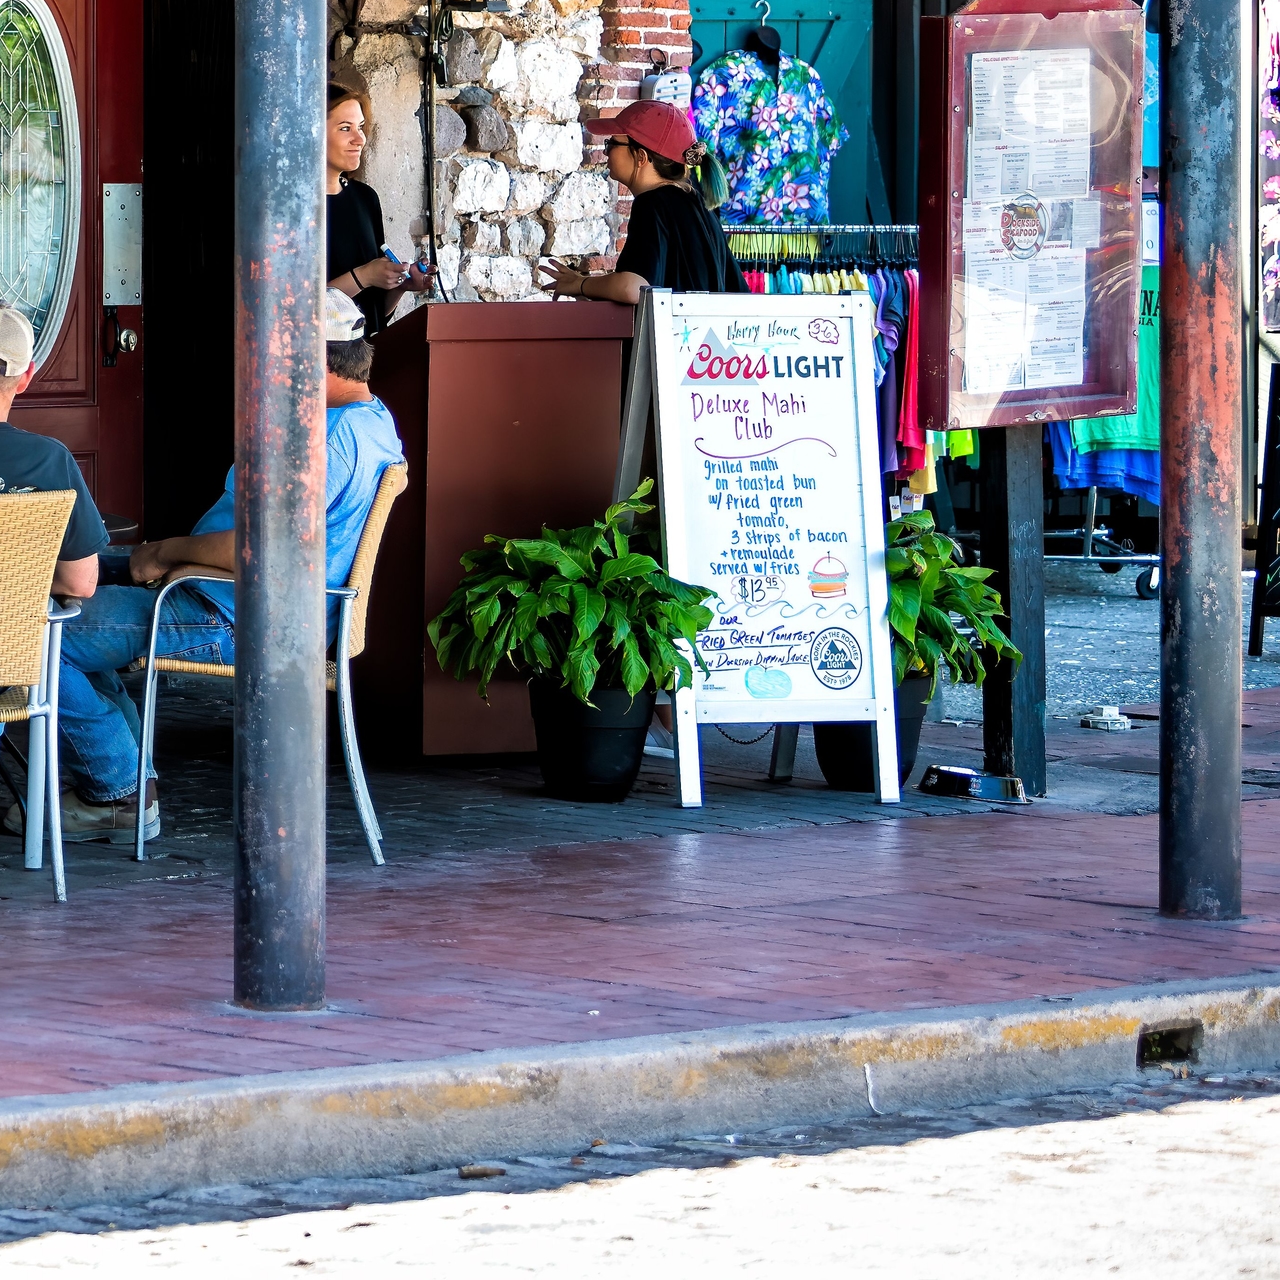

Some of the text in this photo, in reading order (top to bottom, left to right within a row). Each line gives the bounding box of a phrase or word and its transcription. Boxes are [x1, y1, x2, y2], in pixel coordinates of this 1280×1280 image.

[687, 343, 843, 379] Coors LIGHT
[691, 392, 806, 421] Deluxe Mahi
[735, 416, 772, 440] Club
[704, 457, 778, 480] grilled mahi
[716, 474, 816, 491] on toasted bun
[708, 492, 802, 515] w/ fried green
[737, 512, 788, 528] tomato,
[731, 530, 740, 545] 3
[789, 529, 800, 542] of
[807, 529, 847, 543] bacon
[769, 562, 799, 575] fries
[813, 640, 822, 661] BORN
[820, 634, 828, 642] IN
[841, 633, 858, 660] ROCKIES
[823, 649, 850, 662] Coors
